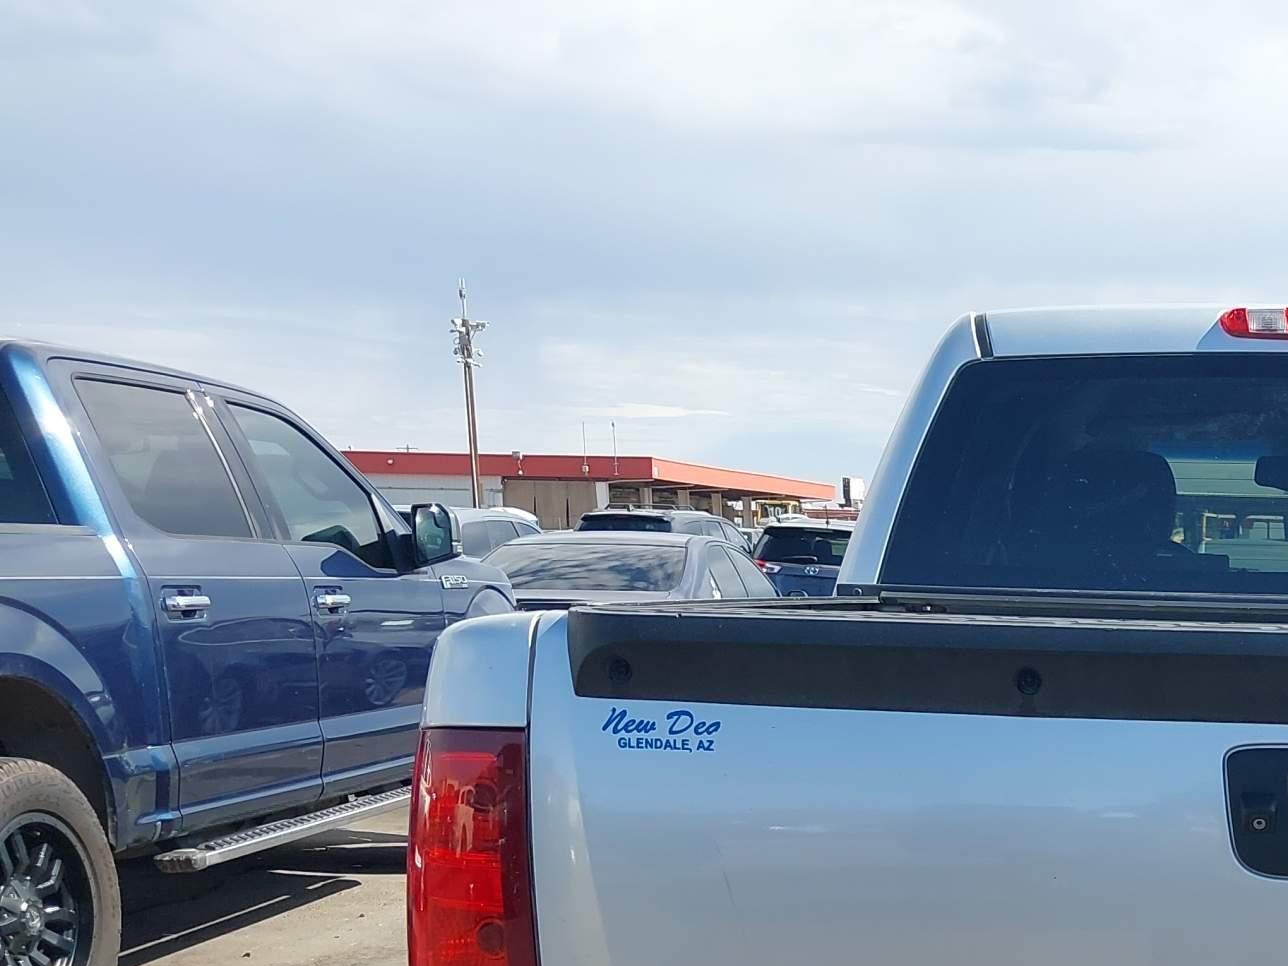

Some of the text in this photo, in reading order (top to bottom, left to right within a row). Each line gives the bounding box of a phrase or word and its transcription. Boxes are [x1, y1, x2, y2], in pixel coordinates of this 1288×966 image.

[601, 706, 657, 735] New
[617, 737, 715, 753] GLENDALE, AZ
